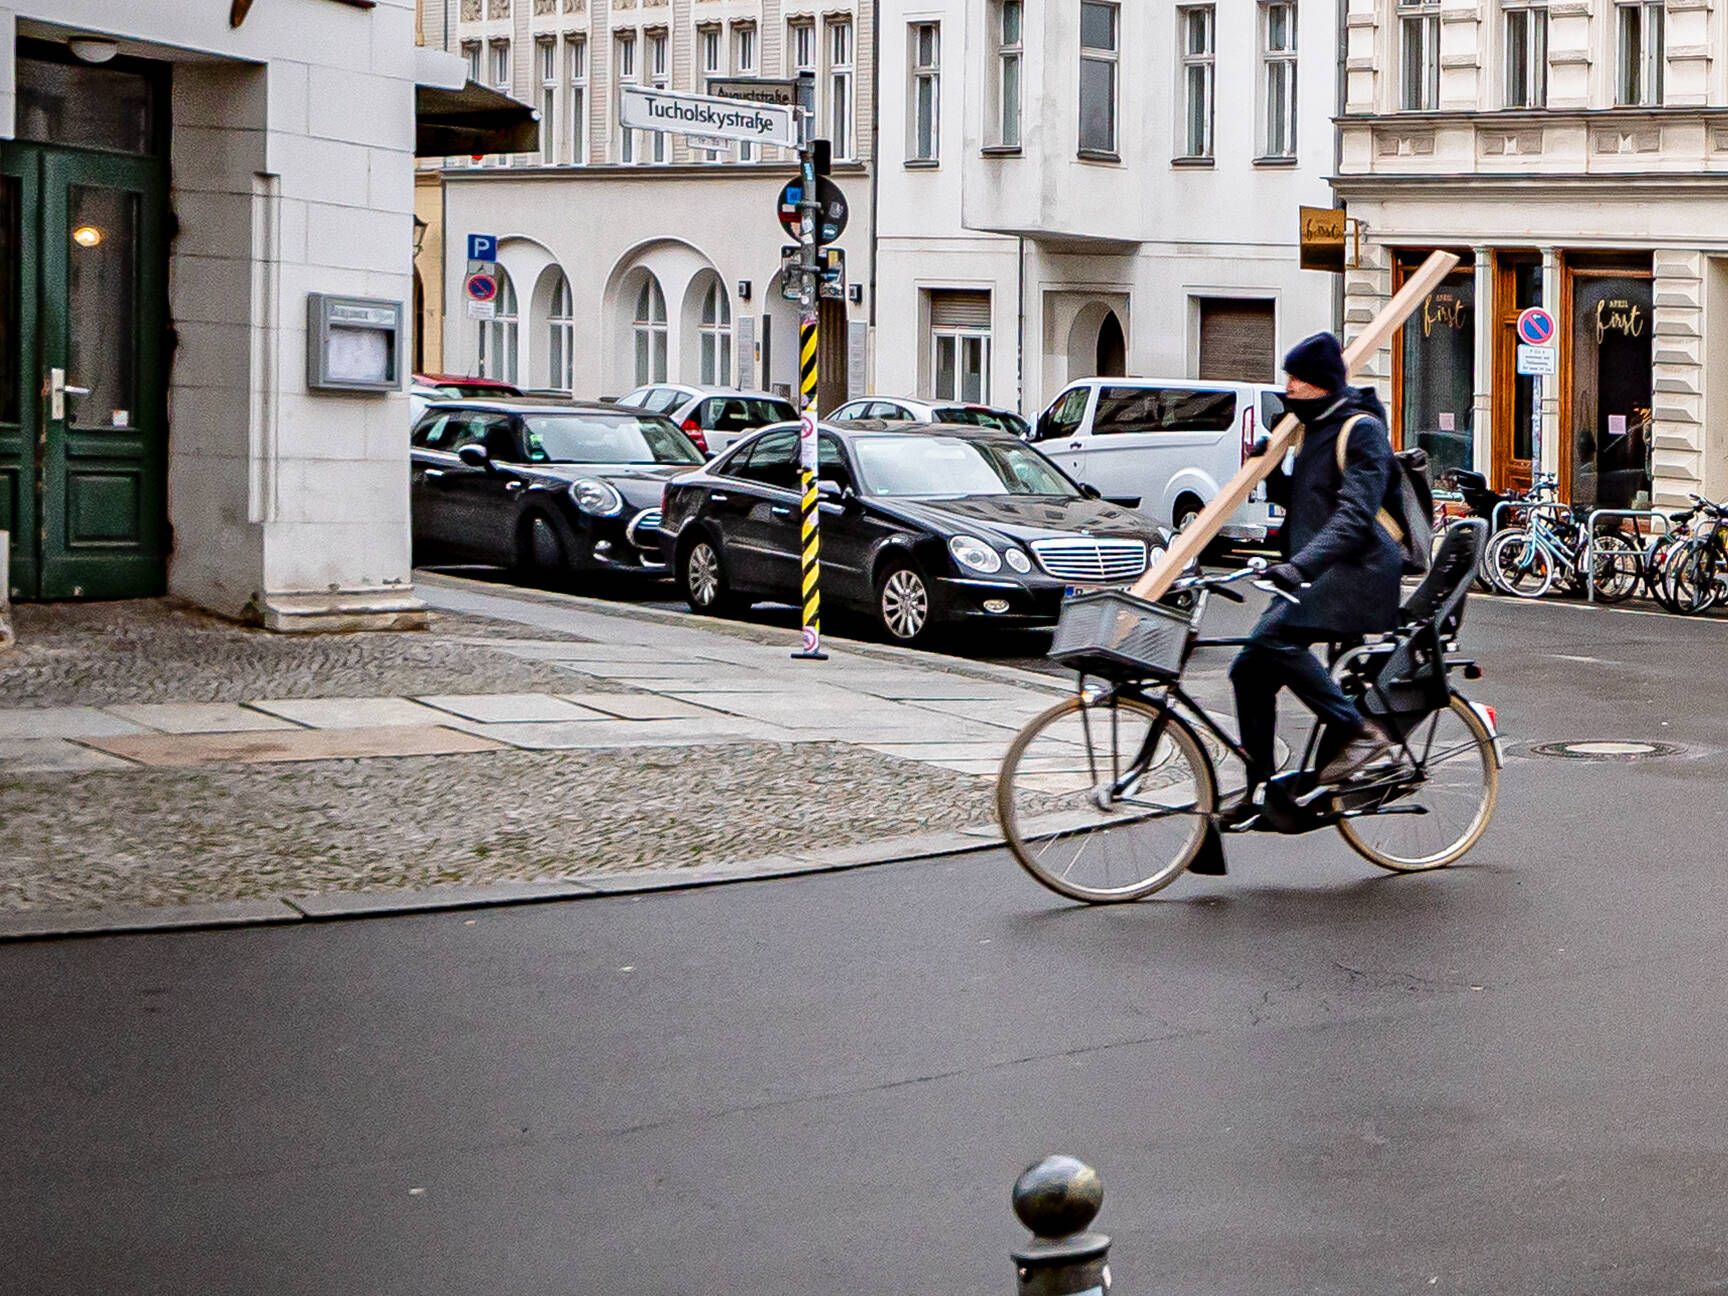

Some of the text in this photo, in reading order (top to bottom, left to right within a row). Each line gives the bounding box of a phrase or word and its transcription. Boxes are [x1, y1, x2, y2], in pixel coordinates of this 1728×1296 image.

[645, 97, 774, 134] Tucholskystraße
[474, 237, 490, 258] P
[1595, 299, 1645, 344] first
